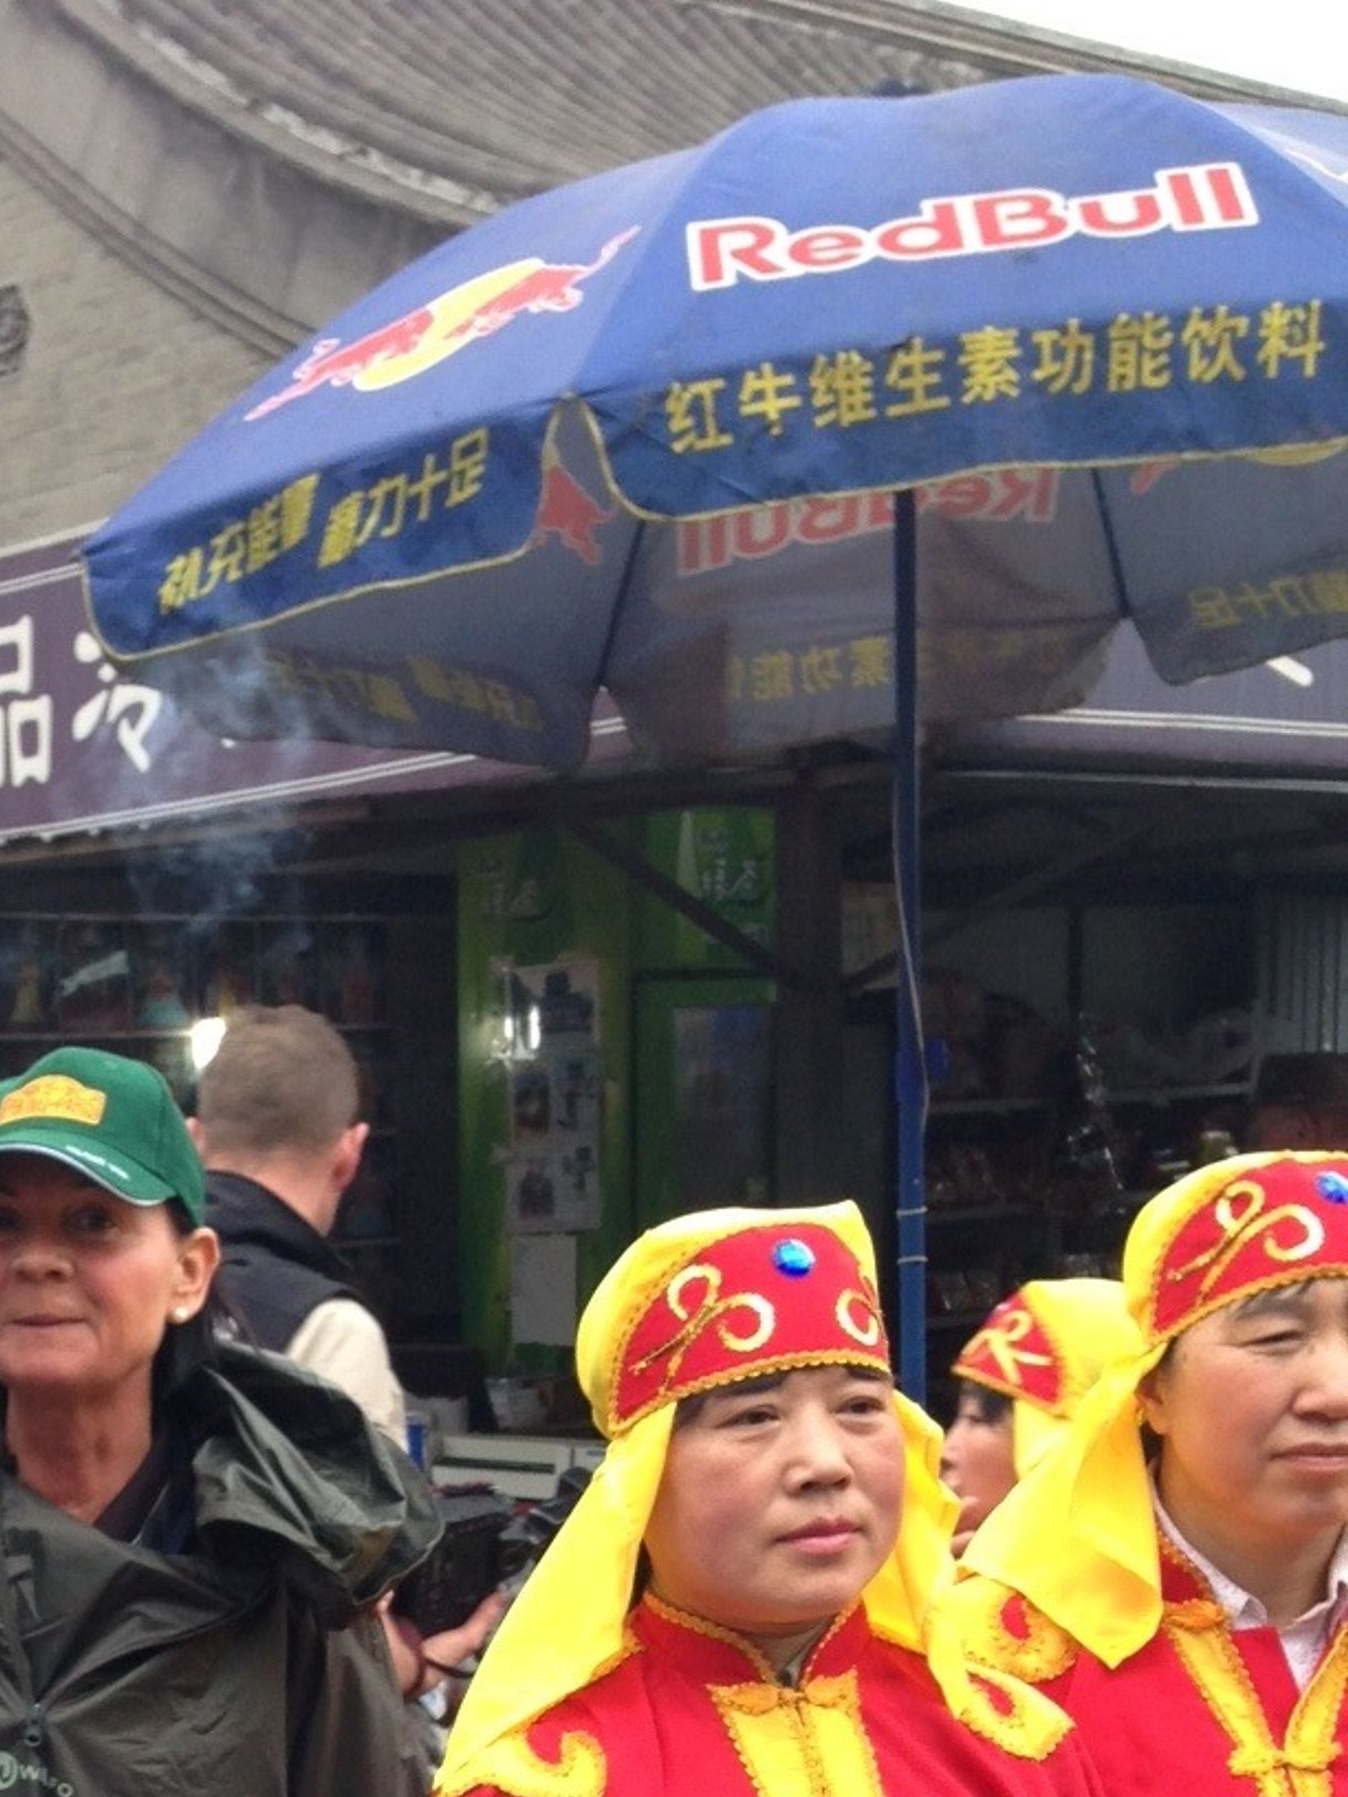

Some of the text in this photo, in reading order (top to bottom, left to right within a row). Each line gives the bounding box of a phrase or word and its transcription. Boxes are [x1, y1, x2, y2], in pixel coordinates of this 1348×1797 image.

[663, 299, 1326, 453] 红牛维生素功能饮料
